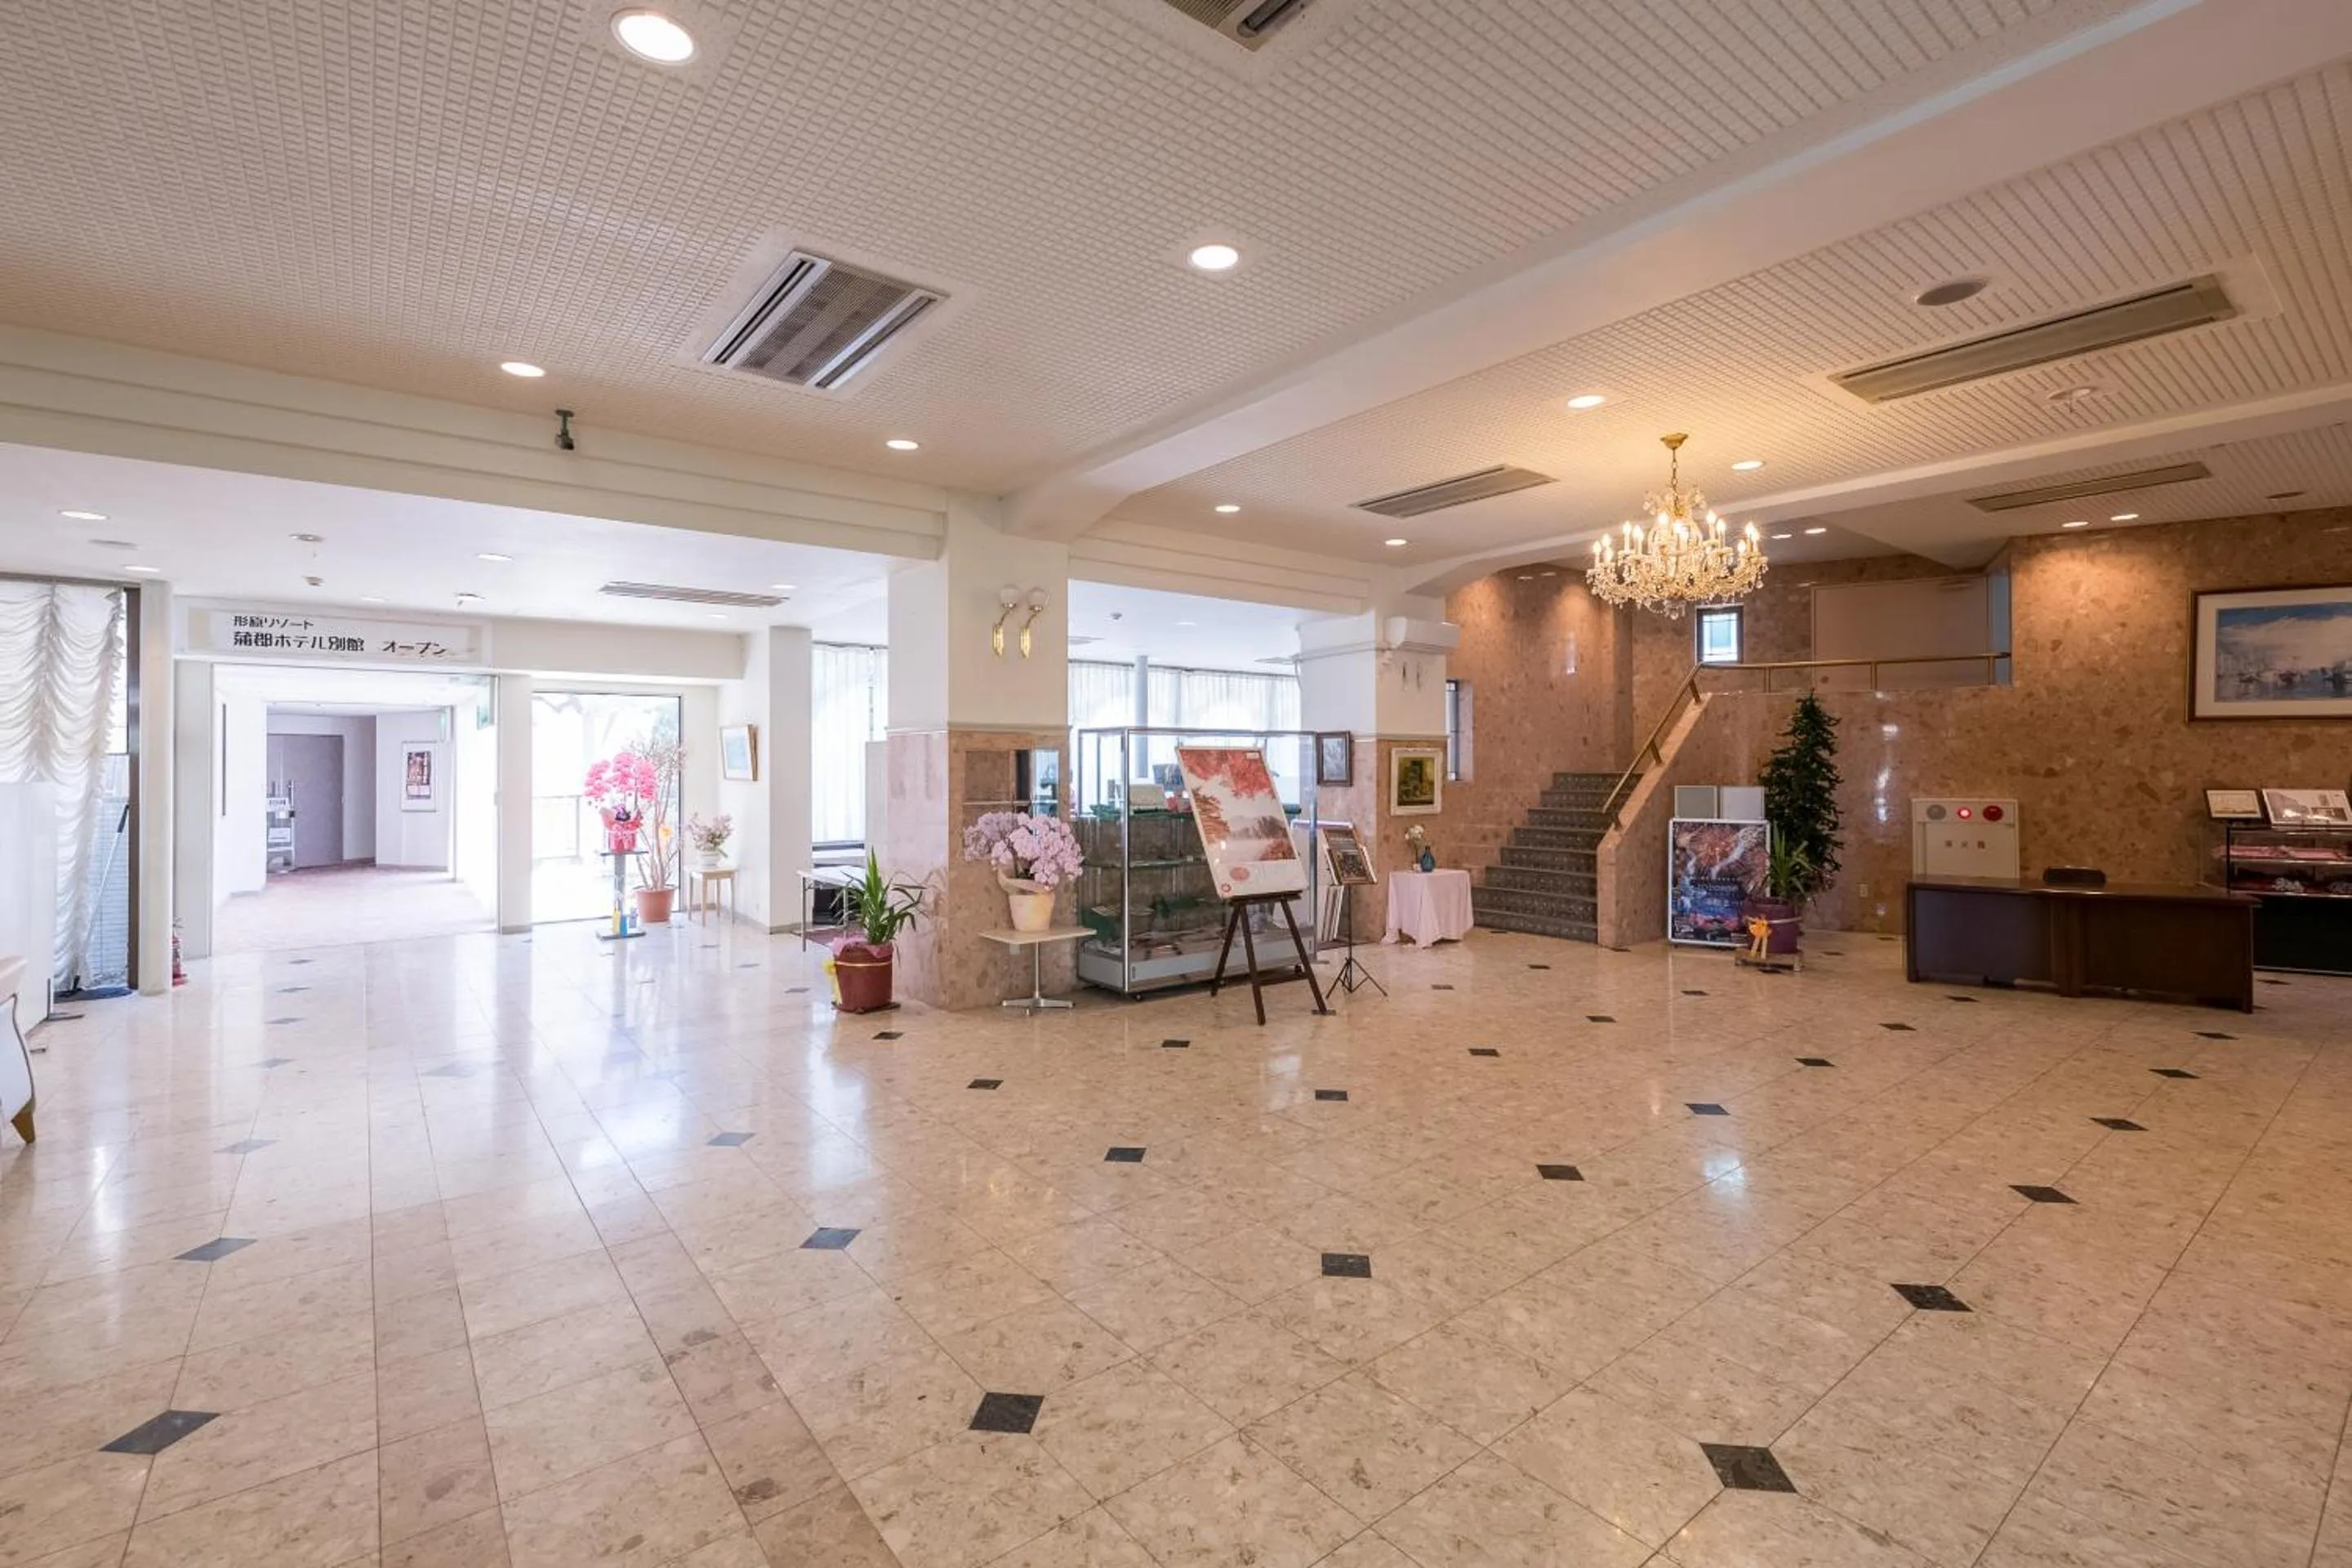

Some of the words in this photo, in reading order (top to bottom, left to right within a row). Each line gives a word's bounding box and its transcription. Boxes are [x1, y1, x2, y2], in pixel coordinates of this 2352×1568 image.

[234, 631, 364, 652] 蒲郡ホテル別館
